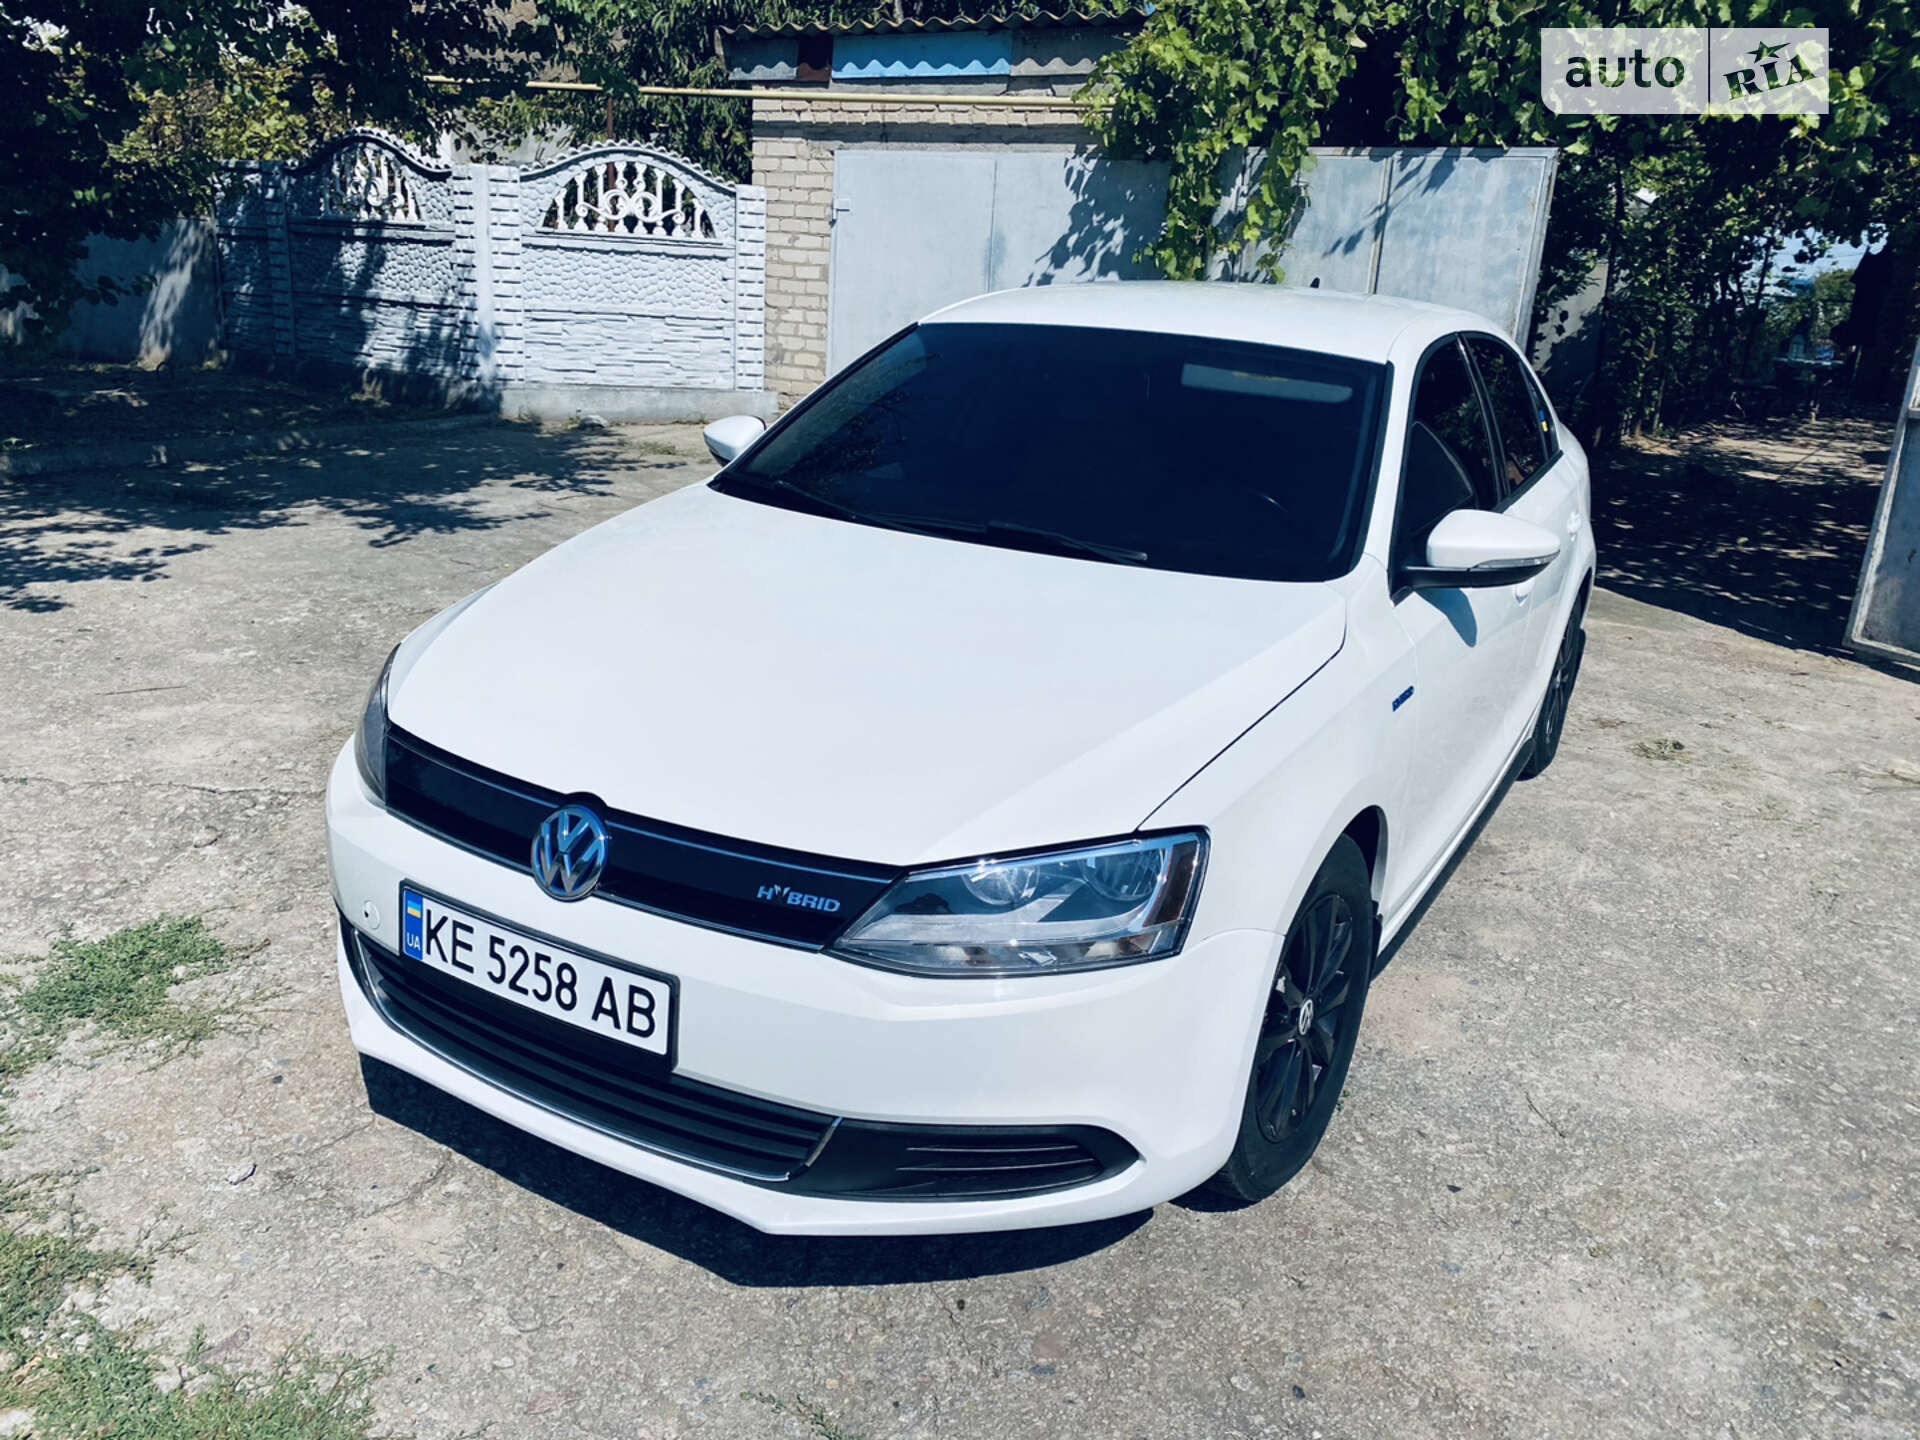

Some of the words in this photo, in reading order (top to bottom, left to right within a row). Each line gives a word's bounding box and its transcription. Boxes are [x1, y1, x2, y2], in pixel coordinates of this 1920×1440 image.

[756, 884, 841, 913] HYBRID
[406, 932, 421, 951] UA
[425, 908, 475, 974] KE
[487, 934, 578, 1012] 5258
[591, 976, 656, 1039] AB
